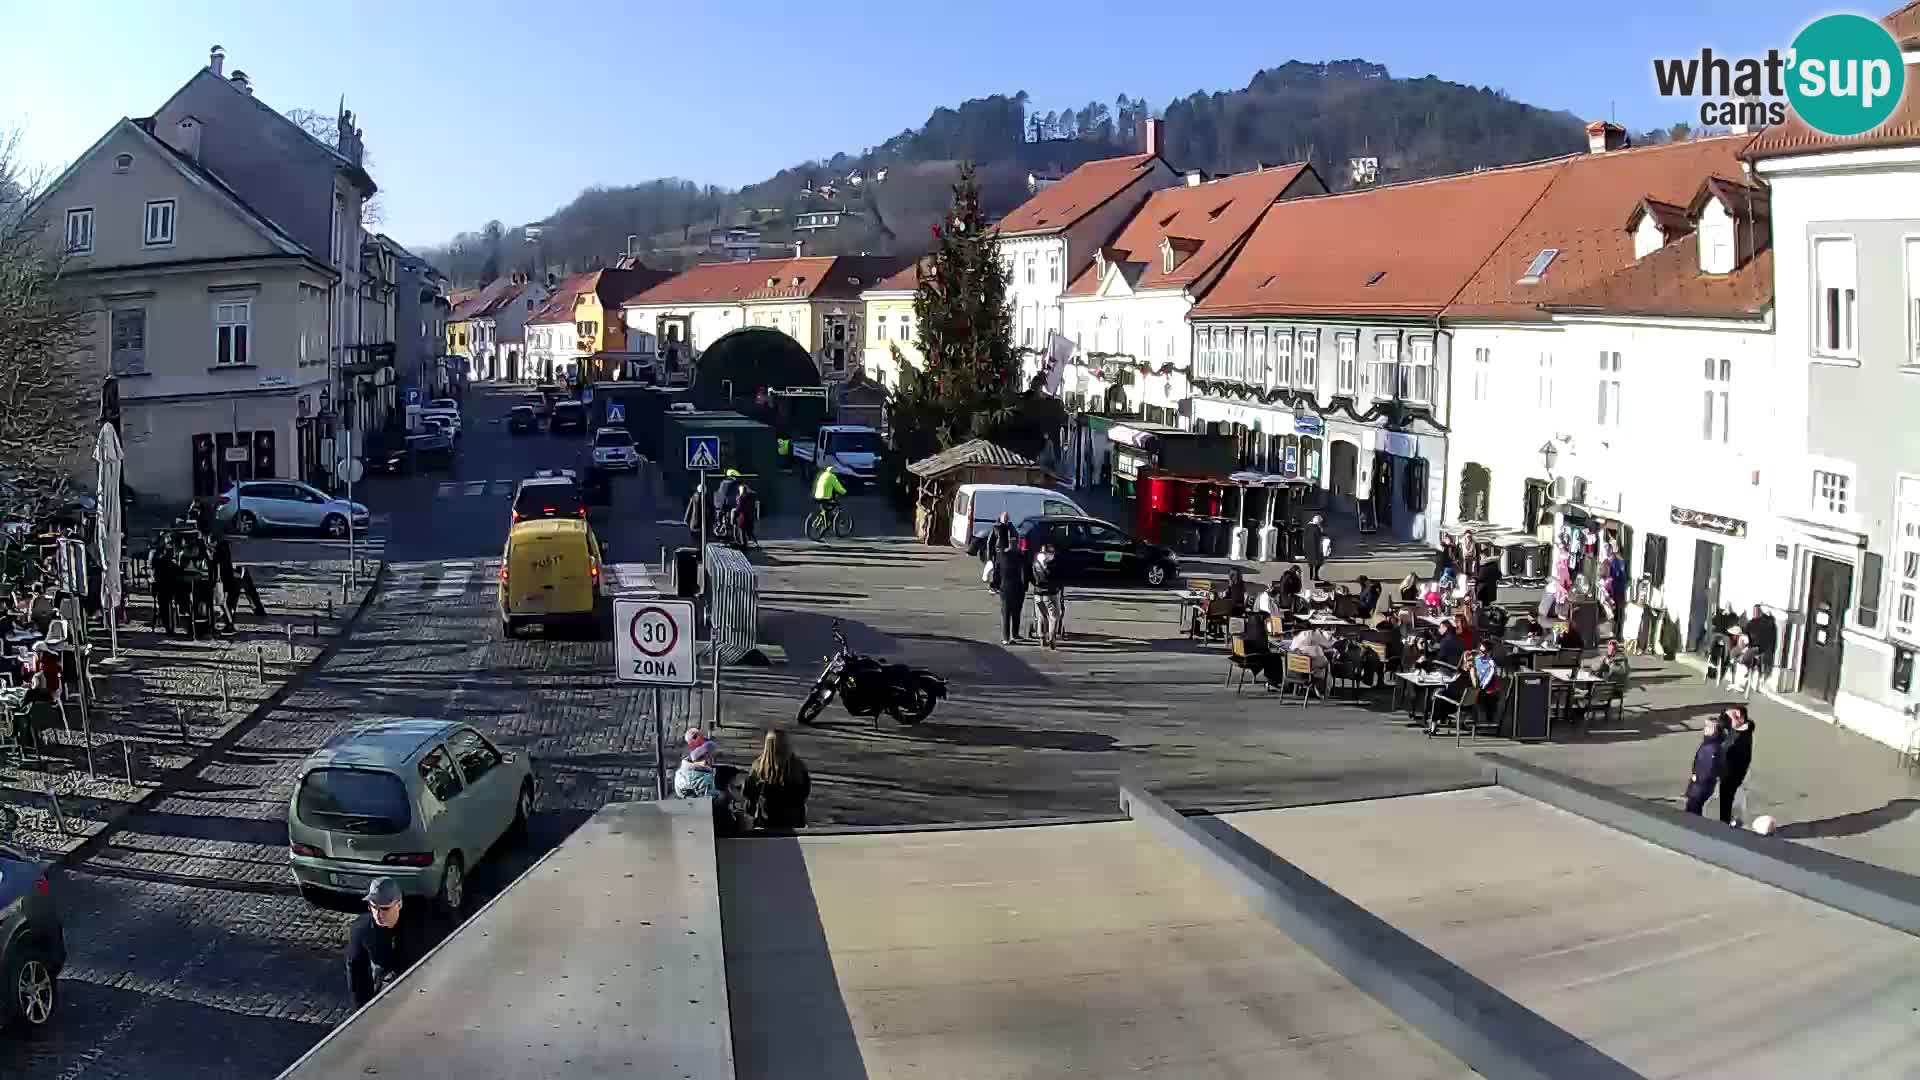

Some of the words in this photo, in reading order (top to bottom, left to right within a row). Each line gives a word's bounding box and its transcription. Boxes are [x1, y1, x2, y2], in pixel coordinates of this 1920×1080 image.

[410, 391, 418, 401] P
[643, 623, 667, 643] 30
[633, 659, 677, 677] ZONA
